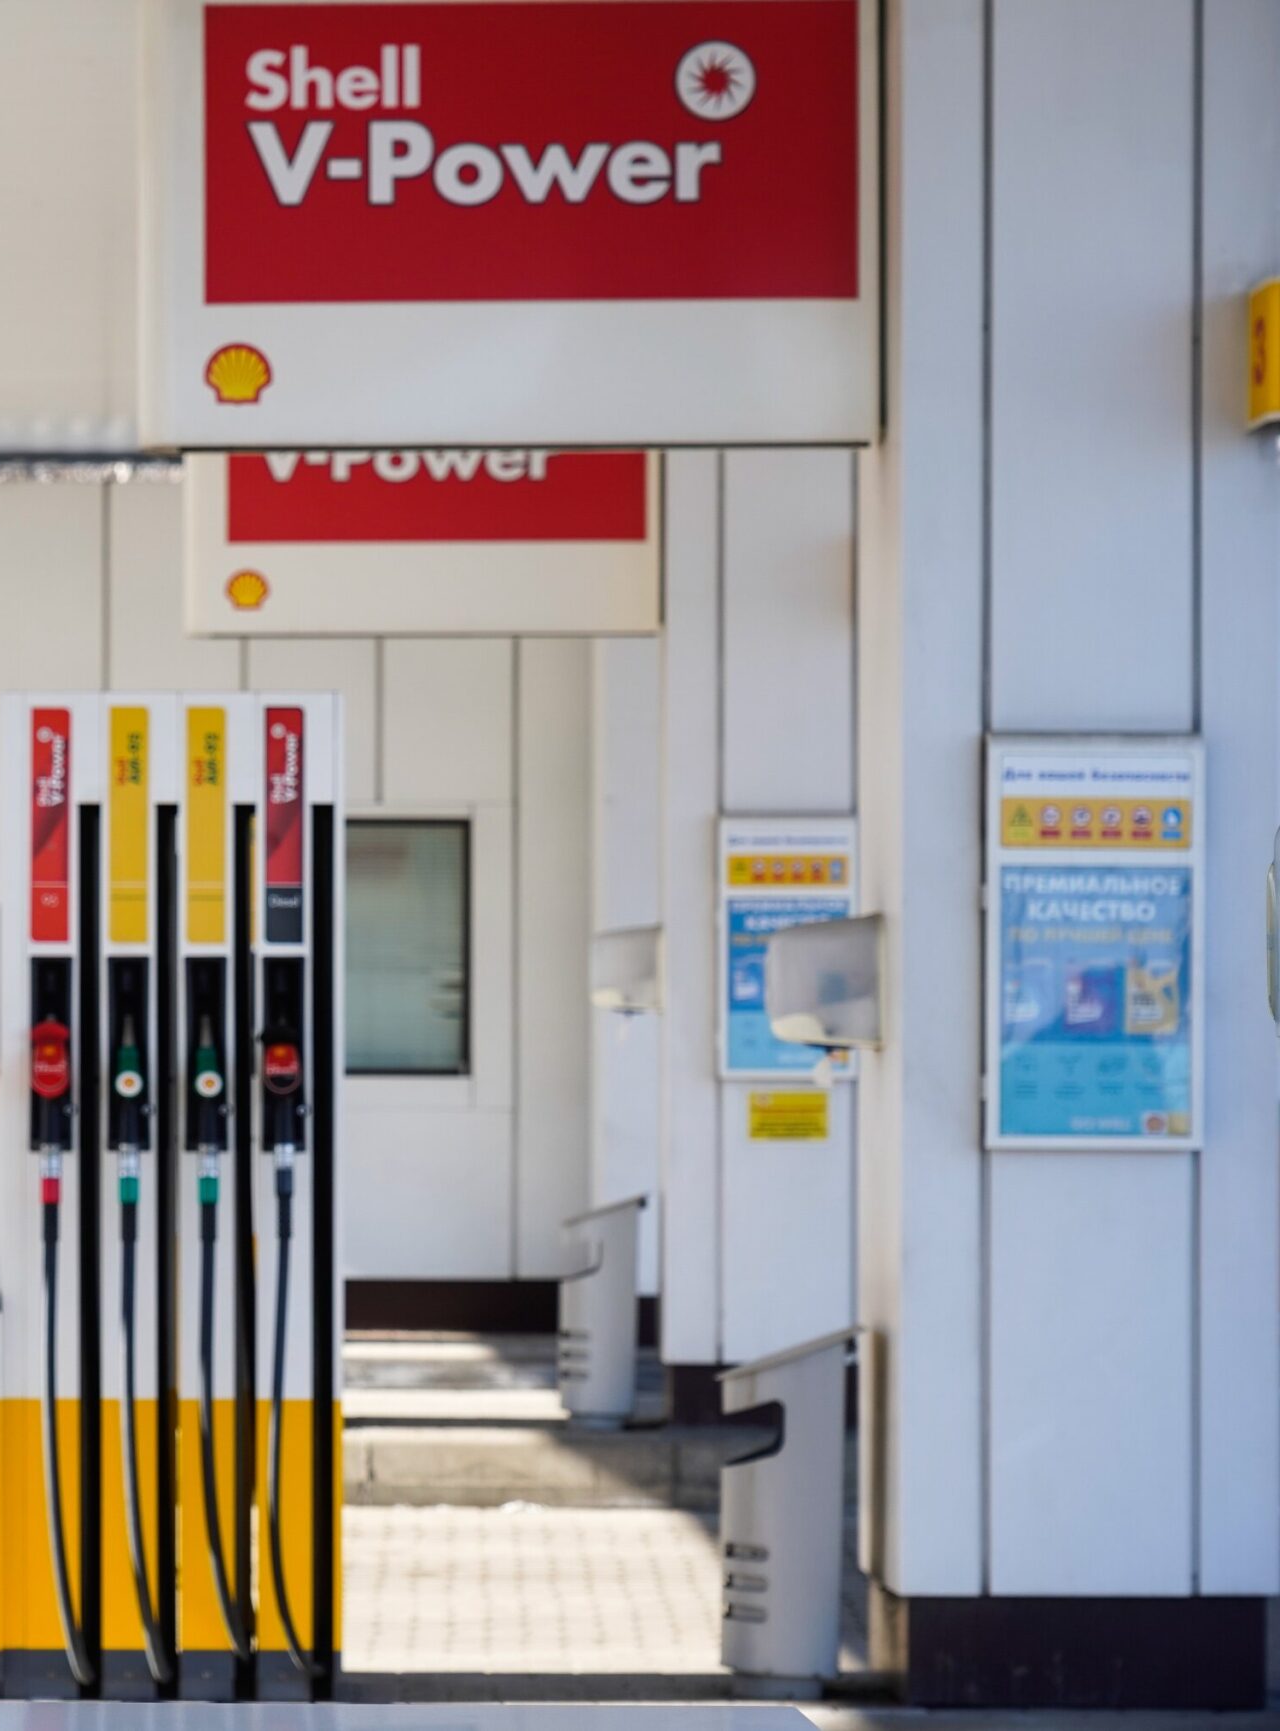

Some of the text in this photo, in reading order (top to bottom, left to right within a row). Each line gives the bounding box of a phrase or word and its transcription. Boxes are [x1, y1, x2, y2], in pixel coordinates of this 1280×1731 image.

[245, 45, 421, 110] Shell
[246, 119, 721, 206] V-Power
[1005, 874, 1182, 896] ПРЕМИАЛЬНОЕ
[1028, 900, 1156, 922] КАЧЕСТВО
